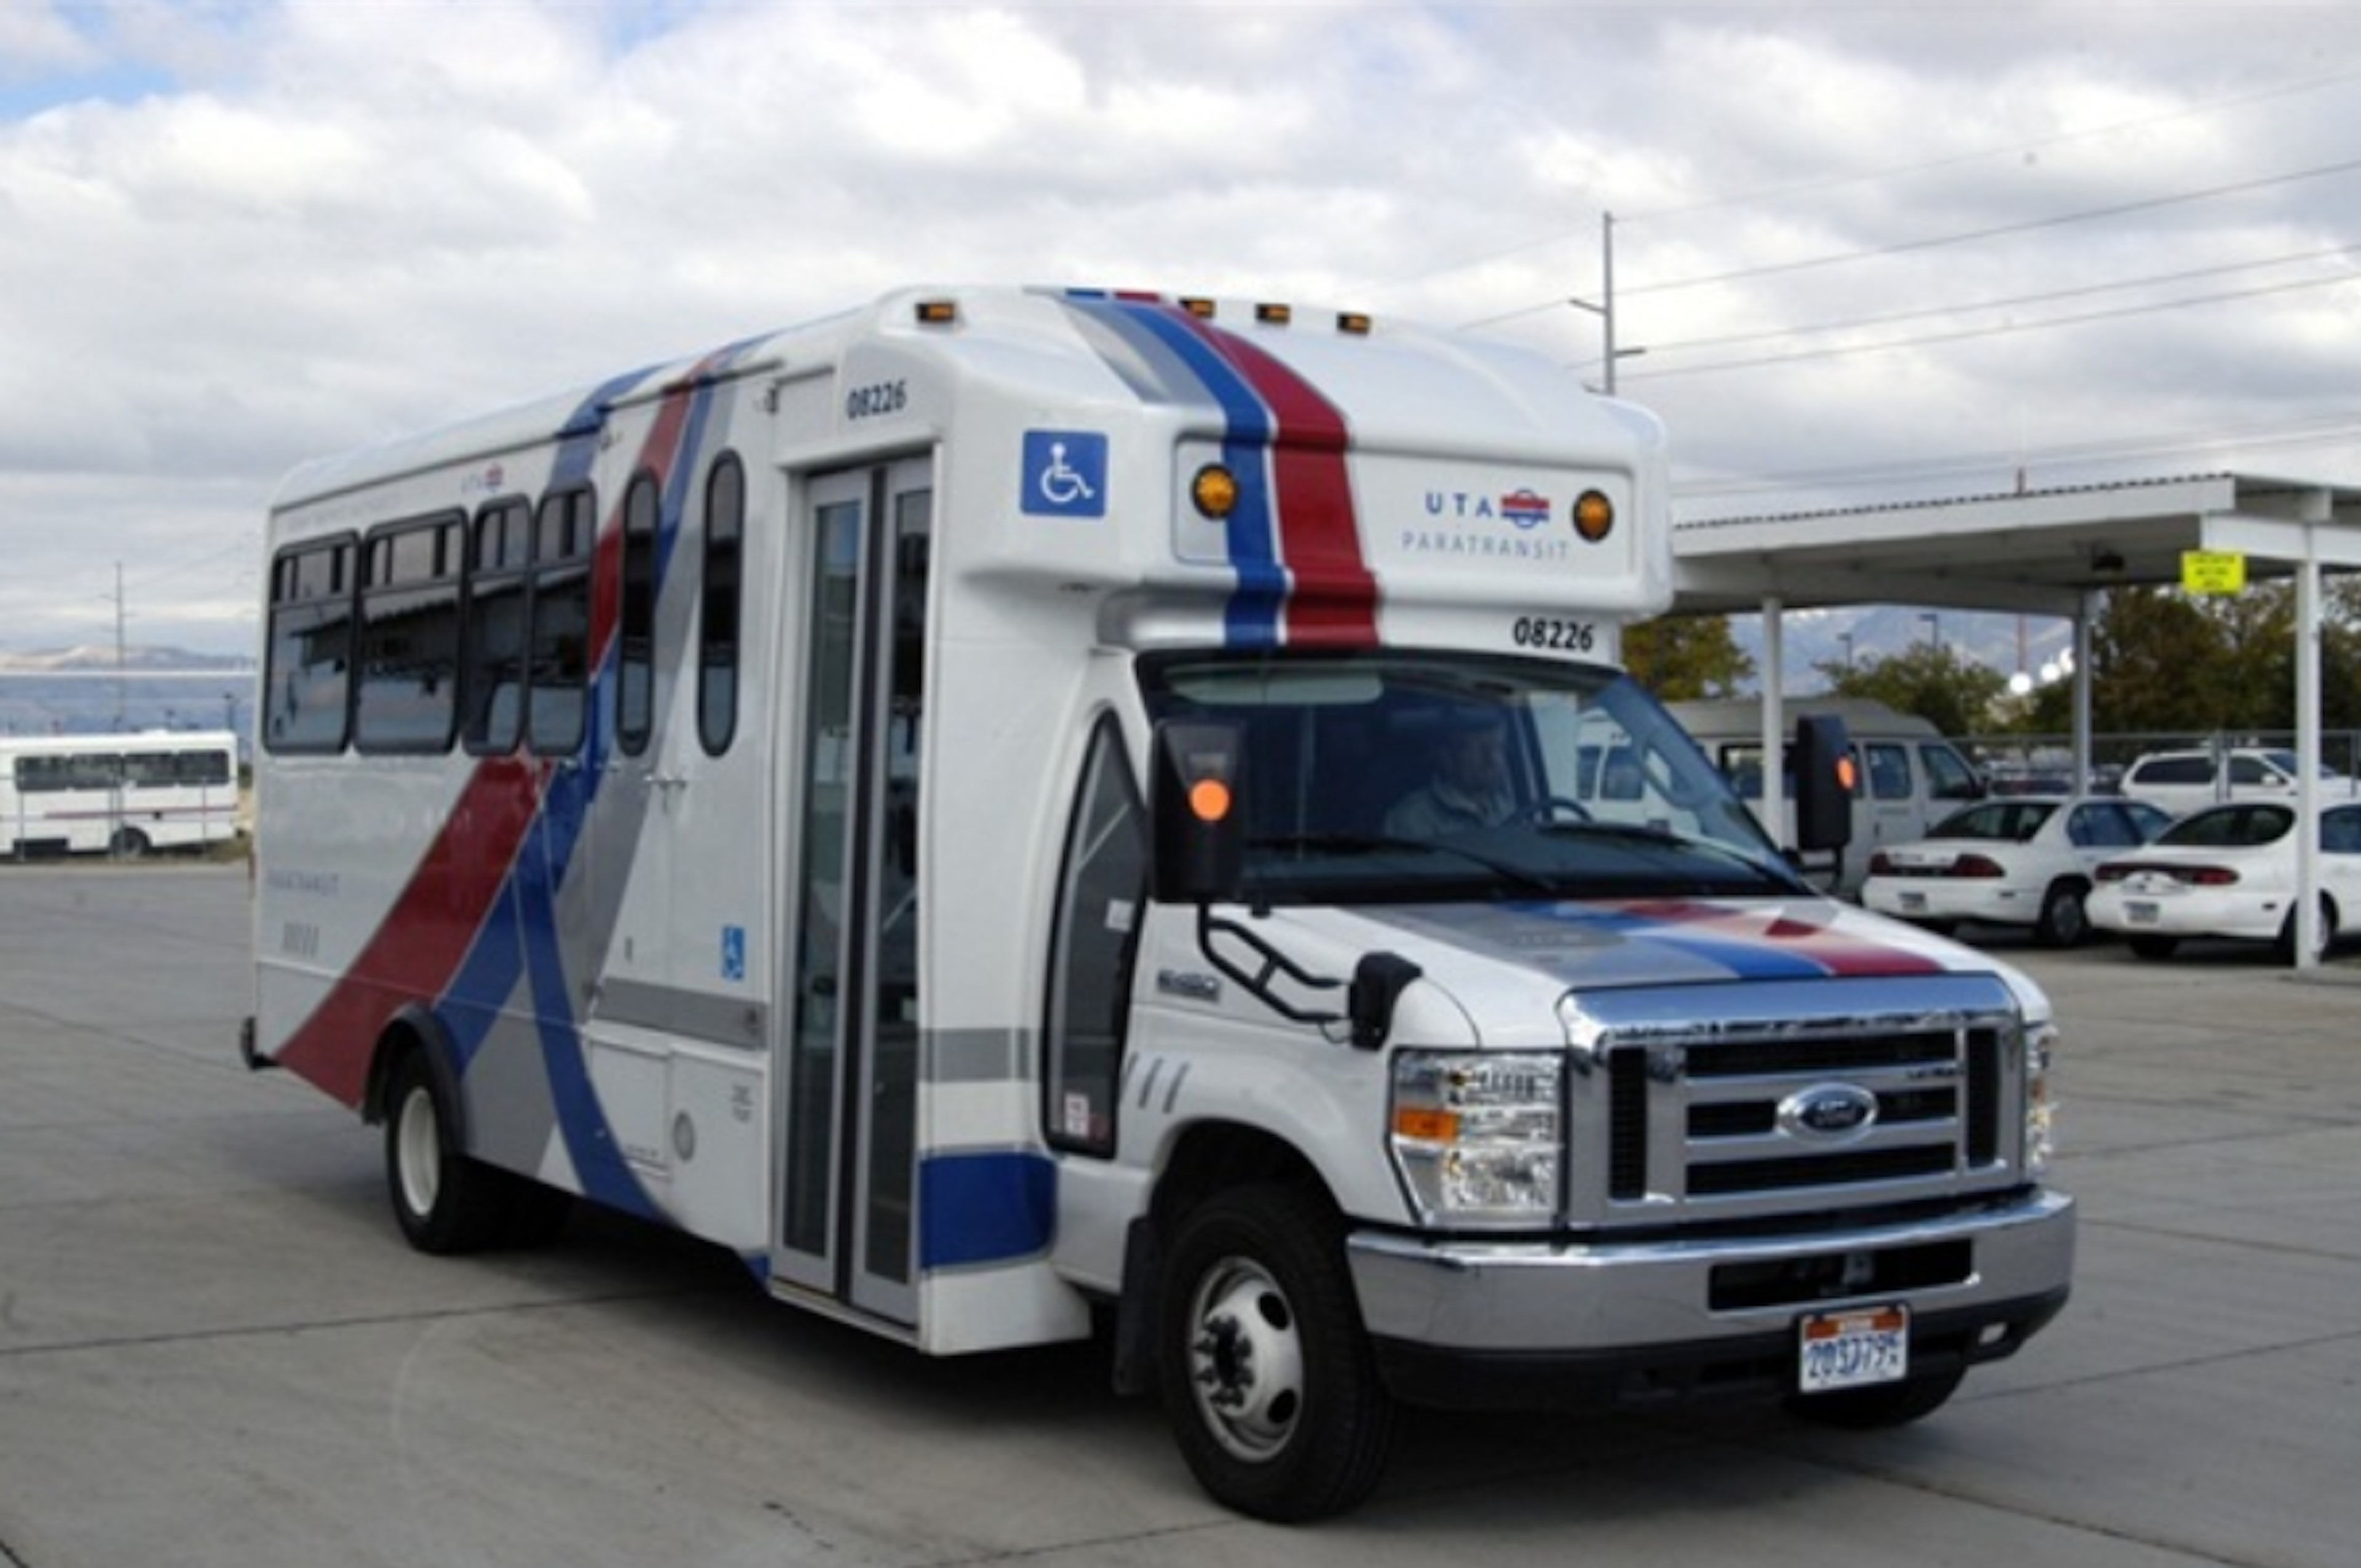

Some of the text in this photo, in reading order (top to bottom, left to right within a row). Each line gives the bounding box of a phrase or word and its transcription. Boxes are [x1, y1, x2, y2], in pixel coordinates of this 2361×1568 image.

[846, 379, 907, 419] 08226
[1425, 492, 1493, 518] UTA
[1401, 531, 1570, 560] PARATRANSIT
[1513, 617, 1594, 652] 08226
